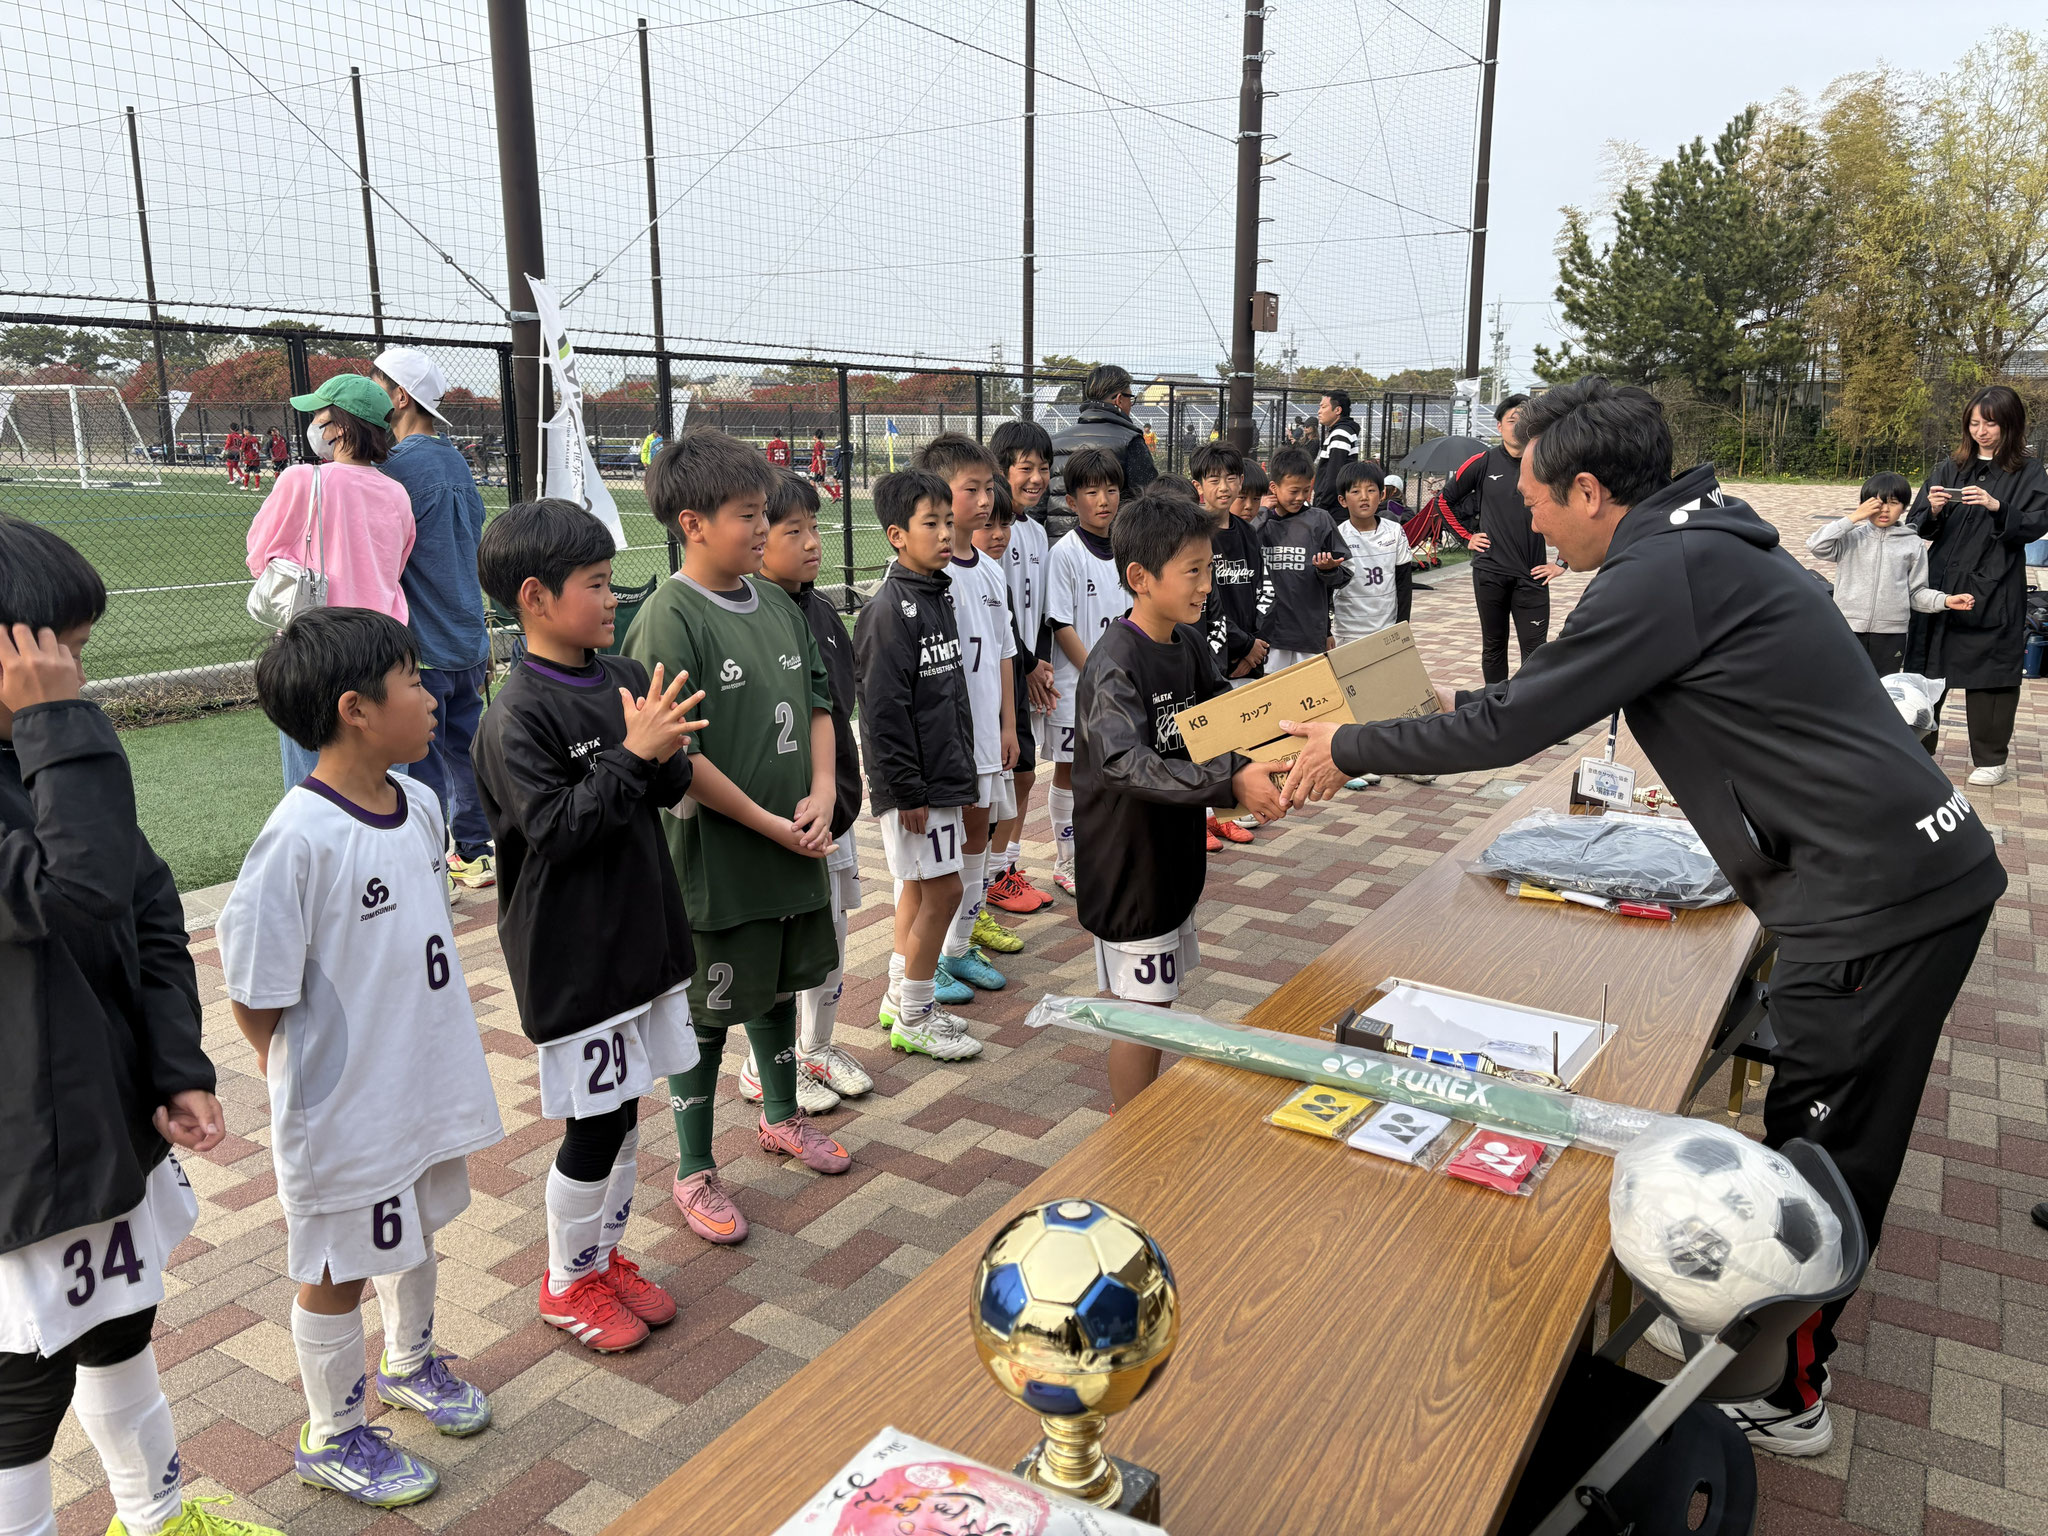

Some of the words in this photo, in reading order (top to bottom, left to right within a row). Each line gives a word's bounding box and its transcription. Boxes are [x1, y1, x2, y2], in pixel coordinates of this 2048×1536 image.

[1363, 566, 1384, 587] 38
[969, 637, 982, 673] 7
[1345, 684, 1357, 698] KB
[775, 701, 798, 755] 2
[1188, 715, 1209, 731] KB
[1239, 701, 1273, 724] カップ
[927, 823, 956, 863] 17
[426, 934, 450, 991] 6
[1134, 952, 1176, 985] 36
[707, 962, 734, 1010] 2
[583, 1031, 628, 1095] 29
[1389, 1064, 1495, 1107] YONEX
[371, 1195, 403, 1250] 6
[63, 1220, 145, 1307] 34
